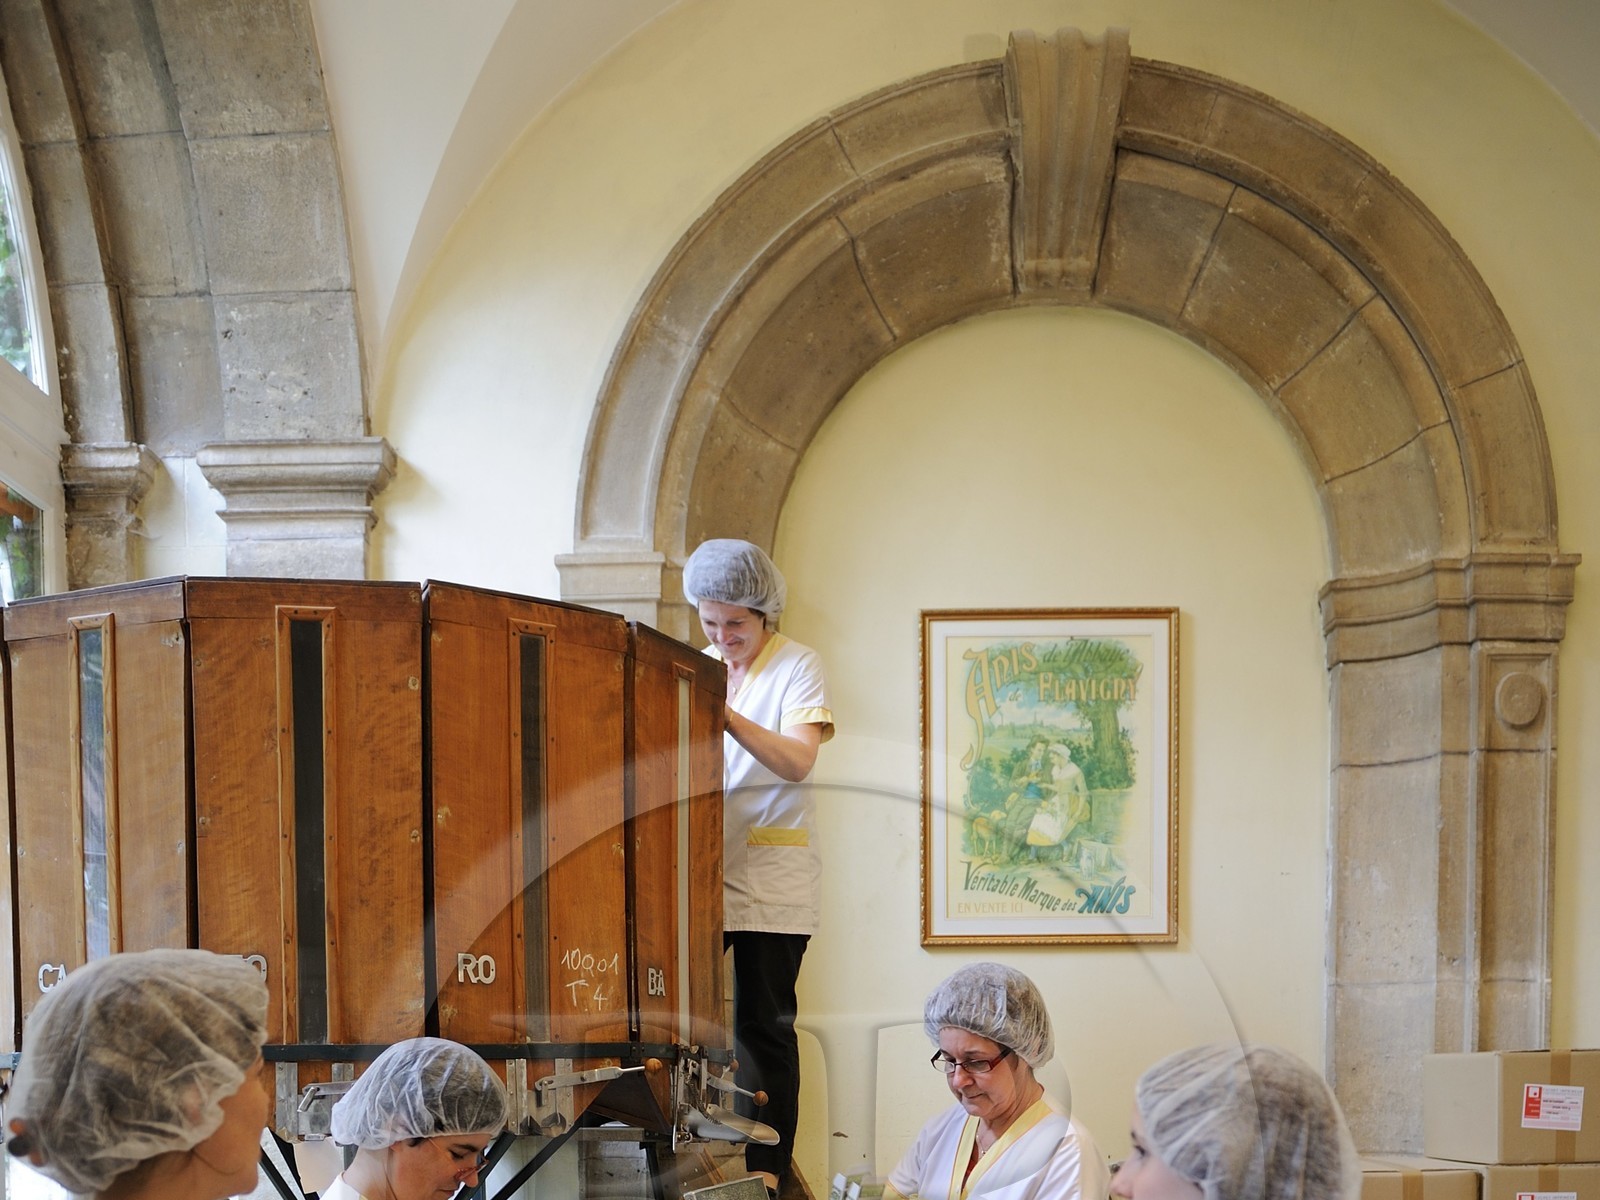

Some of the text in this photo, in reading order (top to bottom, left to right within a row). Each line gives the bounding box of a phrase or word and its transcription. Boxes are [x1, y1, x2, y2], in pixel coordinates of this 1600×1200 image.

[1043, 644, 1058, 664] de
[1008, 688, 1022, 701] de
[960, 861, 1018, 897] Véritable
[1018, 877, 1061, 912] Marque
[1061, 899, 1077, 912] des
[958, 901, 1024, 914] EN VENTE ICI
[457, 953, 496, 985] RO
[648, 967, 666, 996] BA
